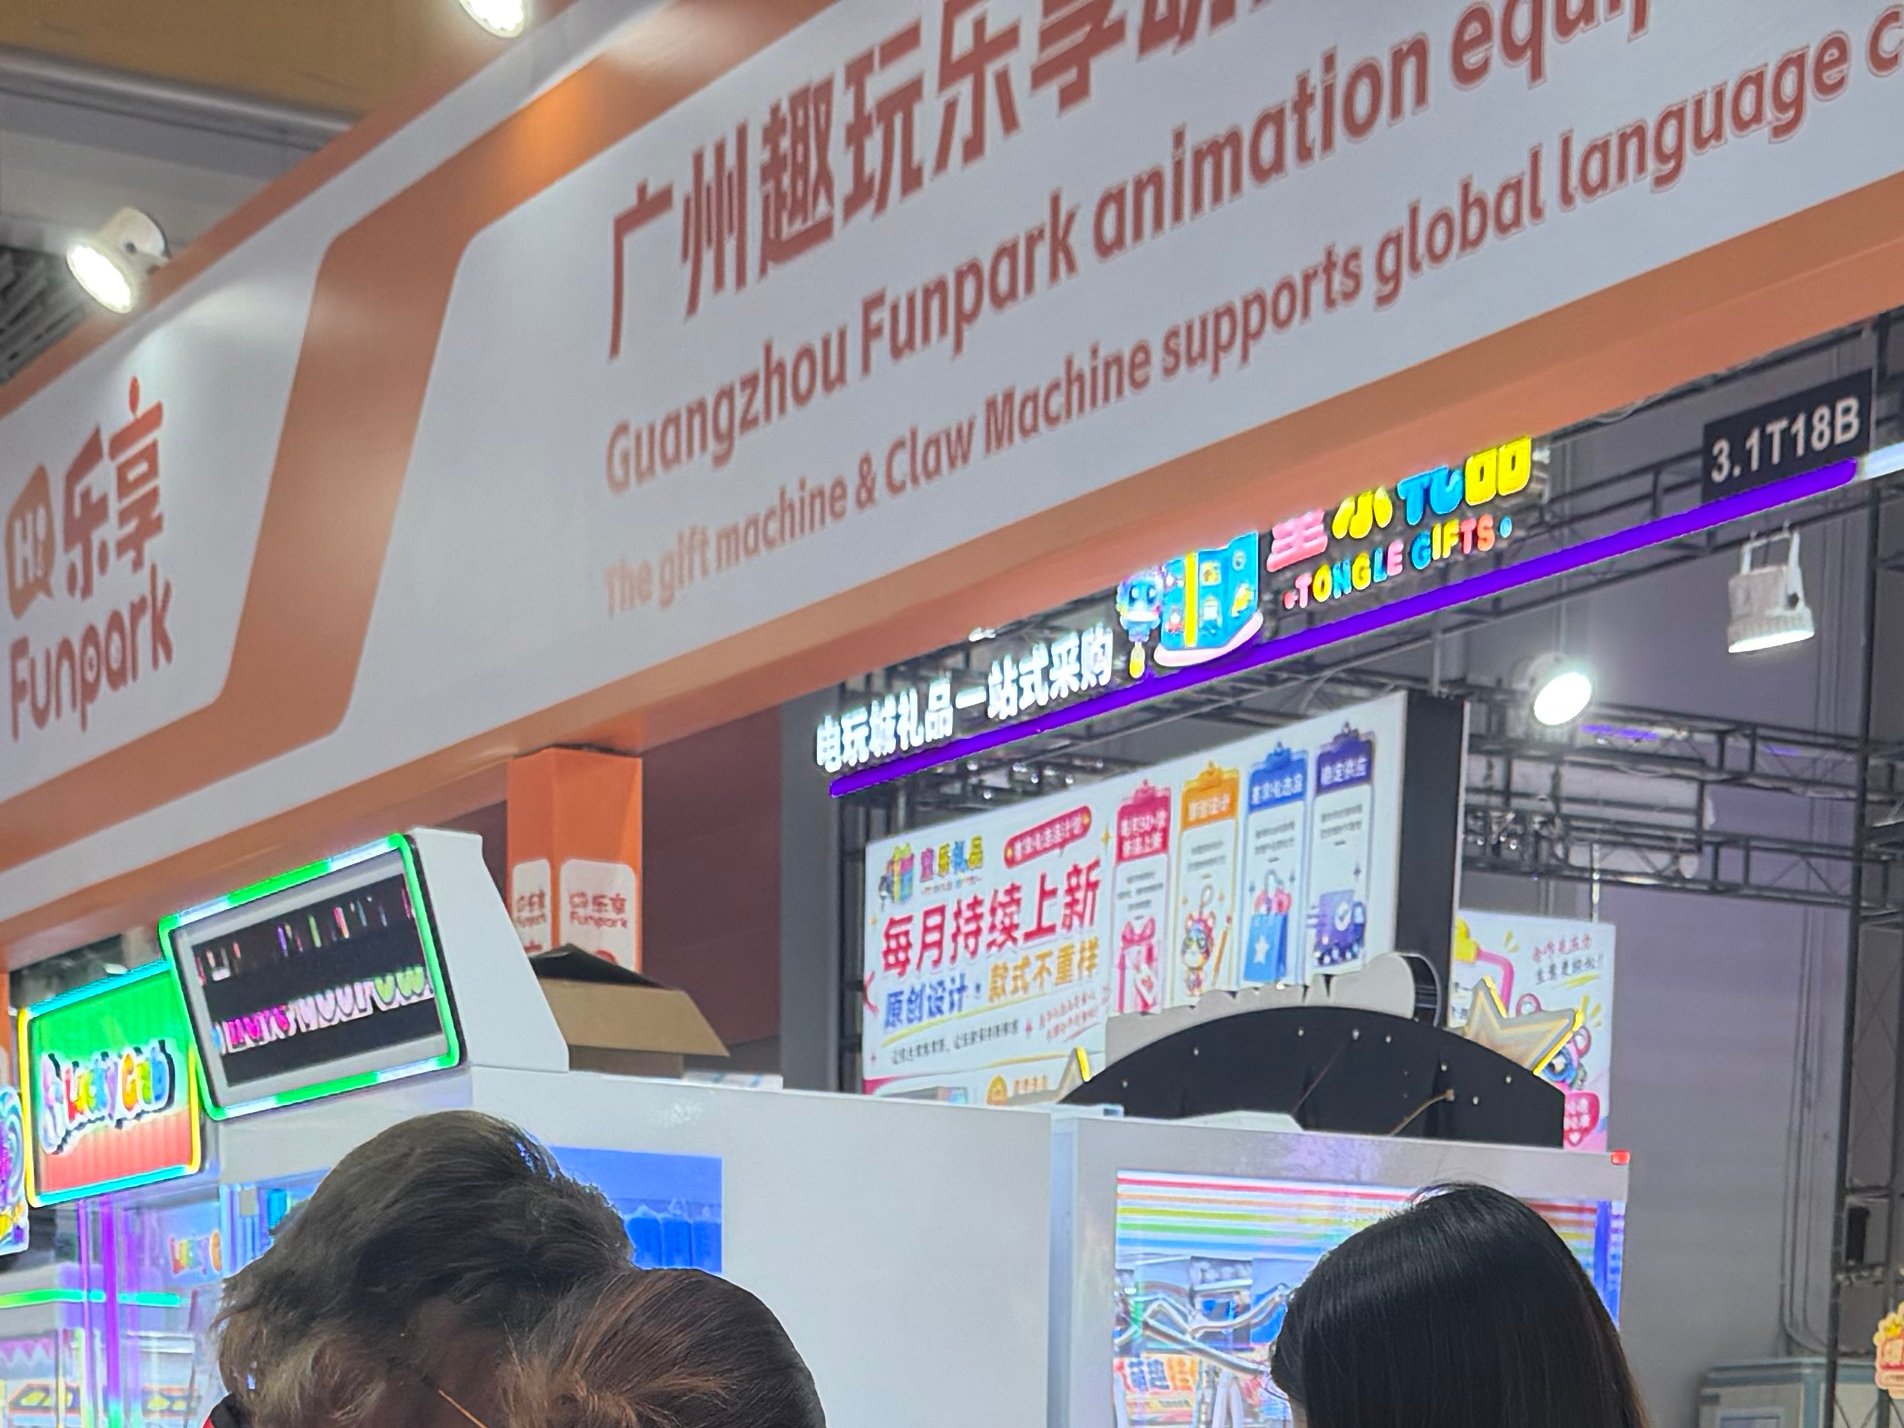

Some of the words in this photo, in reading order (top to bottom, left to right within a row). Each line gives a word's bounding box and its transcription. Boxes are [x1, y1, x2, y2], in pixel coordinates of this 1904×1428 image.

[604, 555, 653, 618] The
[715, 471, 849, 574] machine
[855, 450, 878, 512] &
[884, 414, 977, 497] Claw
[983, 338, 1153, 460] Machine
[1160, 242, 1363, 382] supports
[1373, 142, 1546, 313] global
[1557, 30, 1853, 213] language
[605, 325, 848, 497] Guangzhou
[861, 188, 1081, 376] Funpark
[1092, 32, 1431, 262] animation
[63, 376, 165, 603] 乐享
[1709, 395, 1862, 487] 3.1T18B
[1294, 539, 1405, 610] TONGLE
[1409, 512, 1496, 571] GIFTS
[9, 563, 175, 741] Funpark
[815, 622, 1114, 773] 电玩城礼品一站式采购
[881, 857, 1102, 978] 每月持续上新
